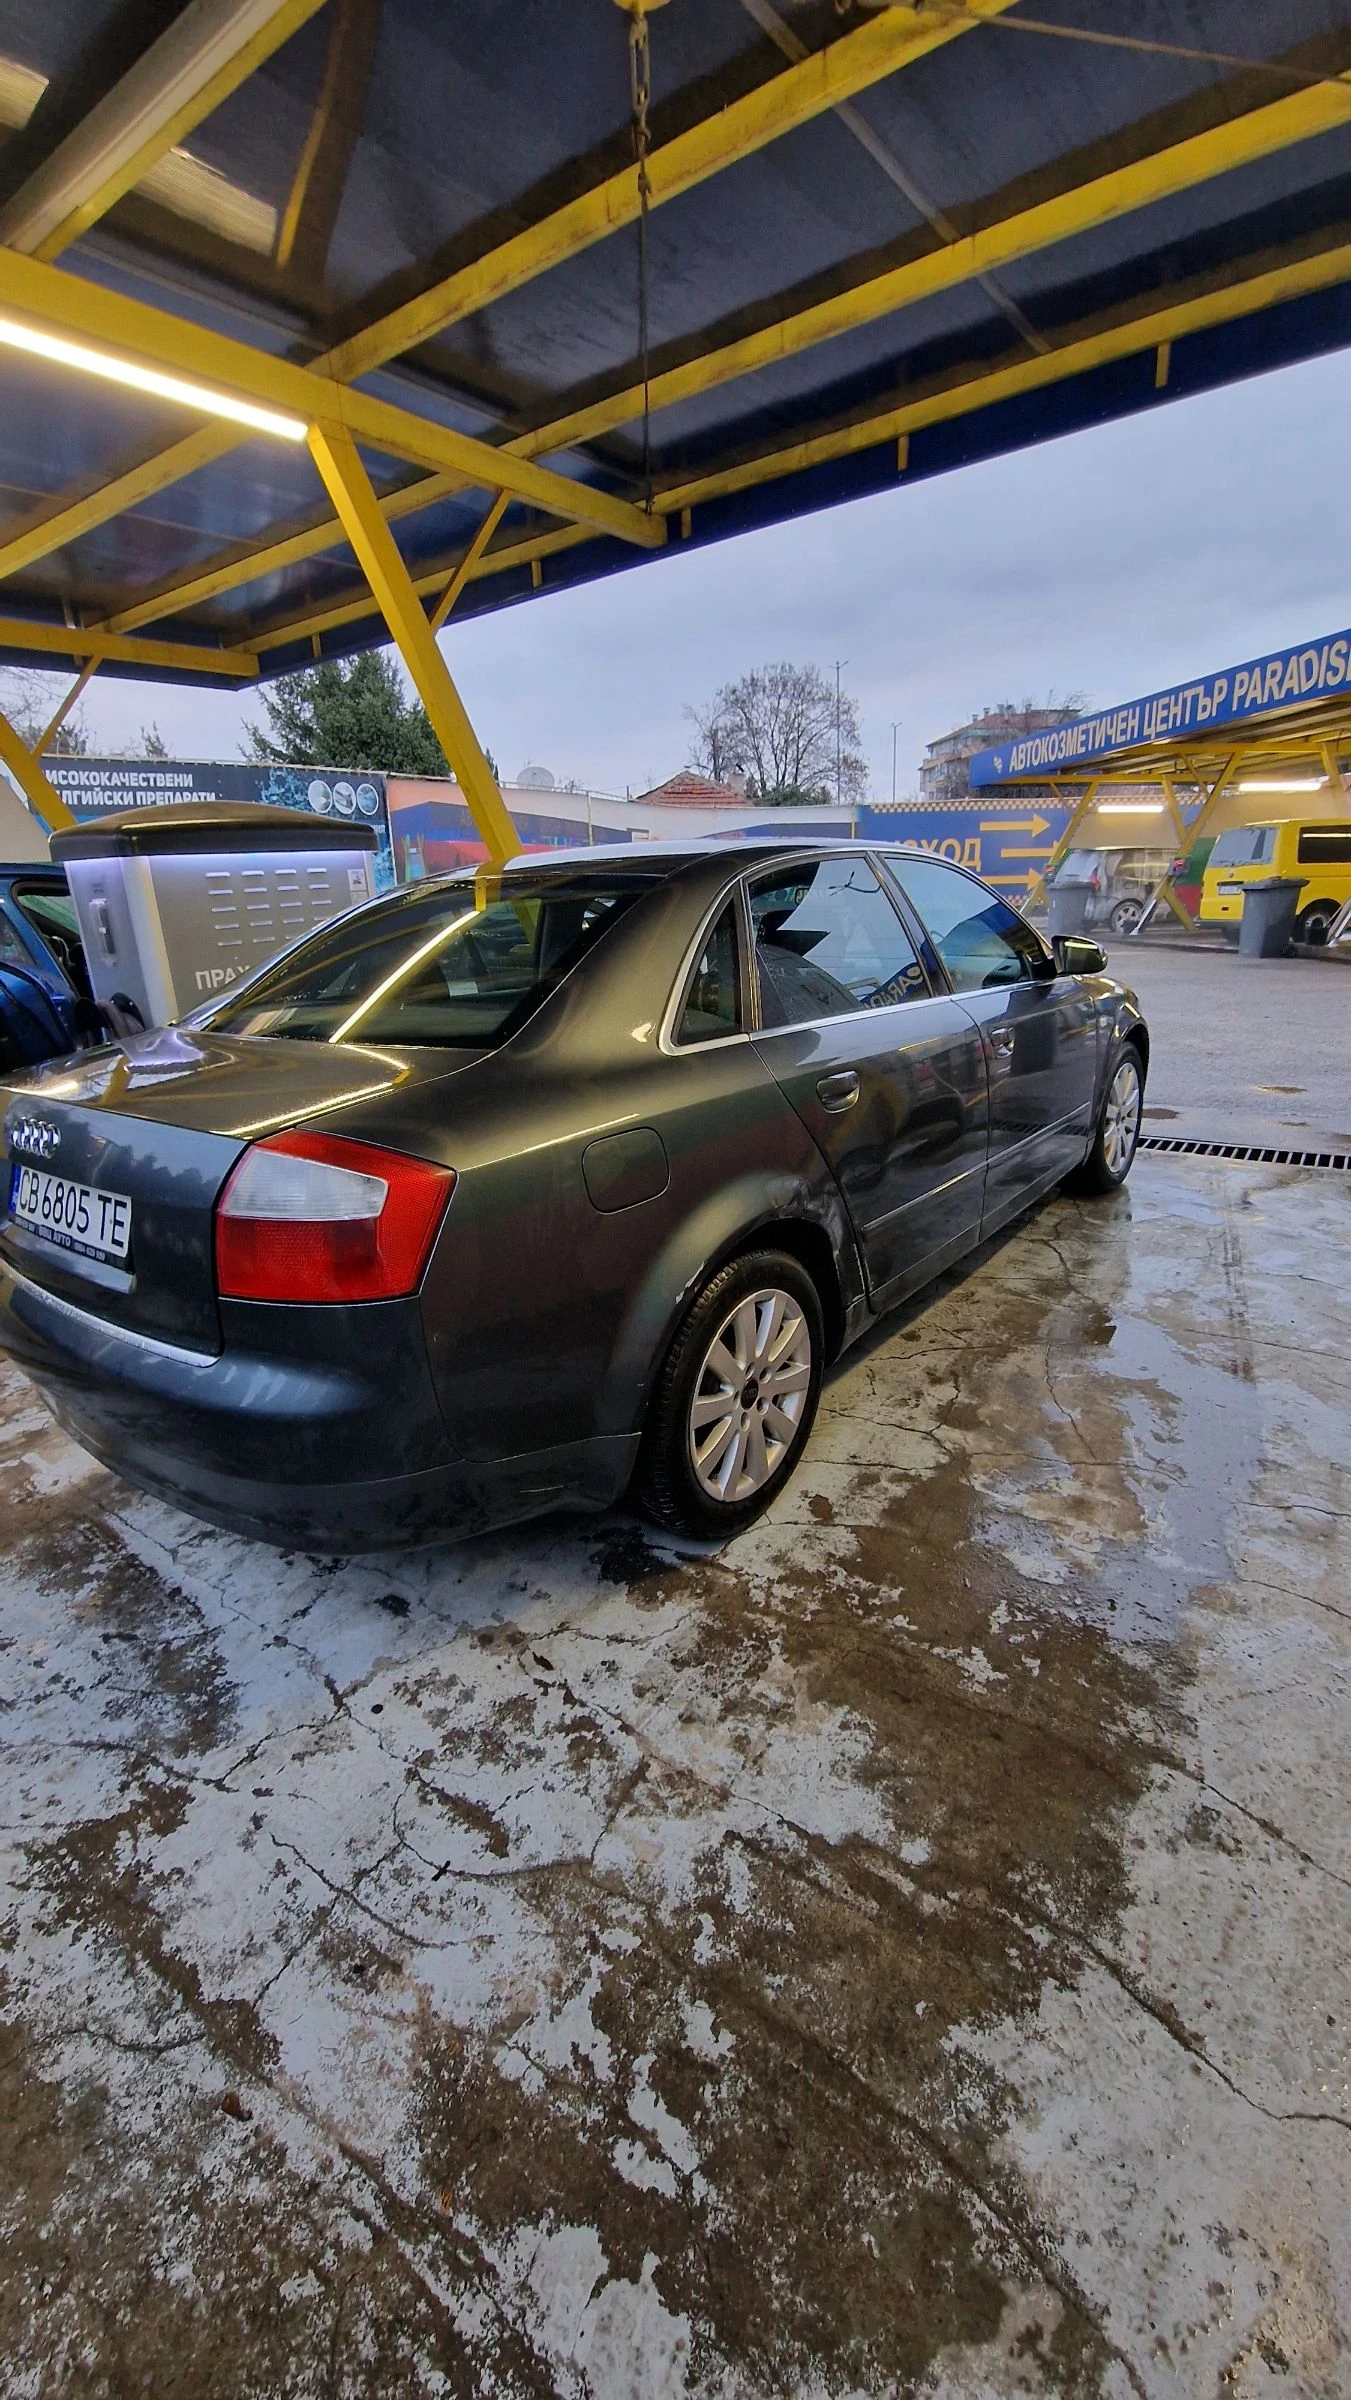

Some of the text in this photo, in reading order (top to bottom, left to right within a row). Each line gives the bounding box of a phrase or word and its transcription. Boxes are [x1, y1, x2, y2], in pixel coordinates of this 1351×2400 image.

[1009, 711, 1139, 772] АВТОКОЗМЕТИЧЕН
[1143, 678, 1228, 739] ЦЕНТЪР
[43, 769, 193, 788] ИСОКОКАЧЕСТВЕНИ
[56, 787, 133, 806] ЛГИЙСКИ
[887, 838, 982, 872] ХОД
[20, 1169, 128, 1248] CB 6805 TE
